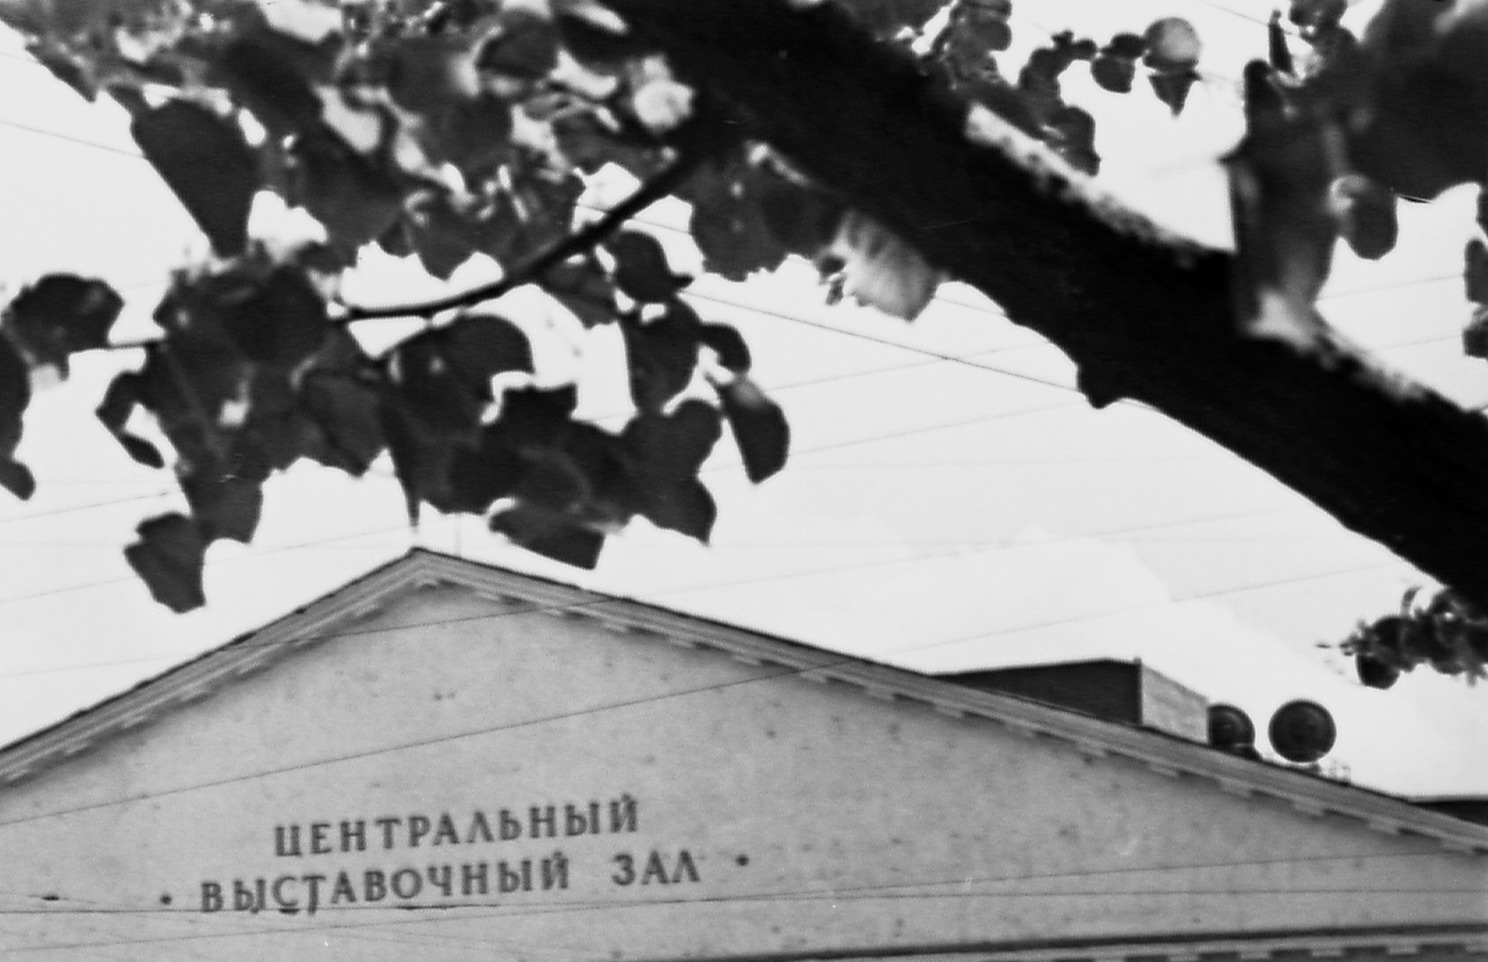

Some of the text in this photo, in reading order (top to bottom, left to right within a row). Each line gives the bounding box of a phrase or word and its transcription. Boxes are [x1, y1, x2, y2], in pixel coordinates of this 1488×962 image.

[274, 793, 639, 858] ЦЕНТРАЛЬНЫЙ
[199, 847, 703, 915] ВЫСТАВОЧНЫЙ ЗАЛ
